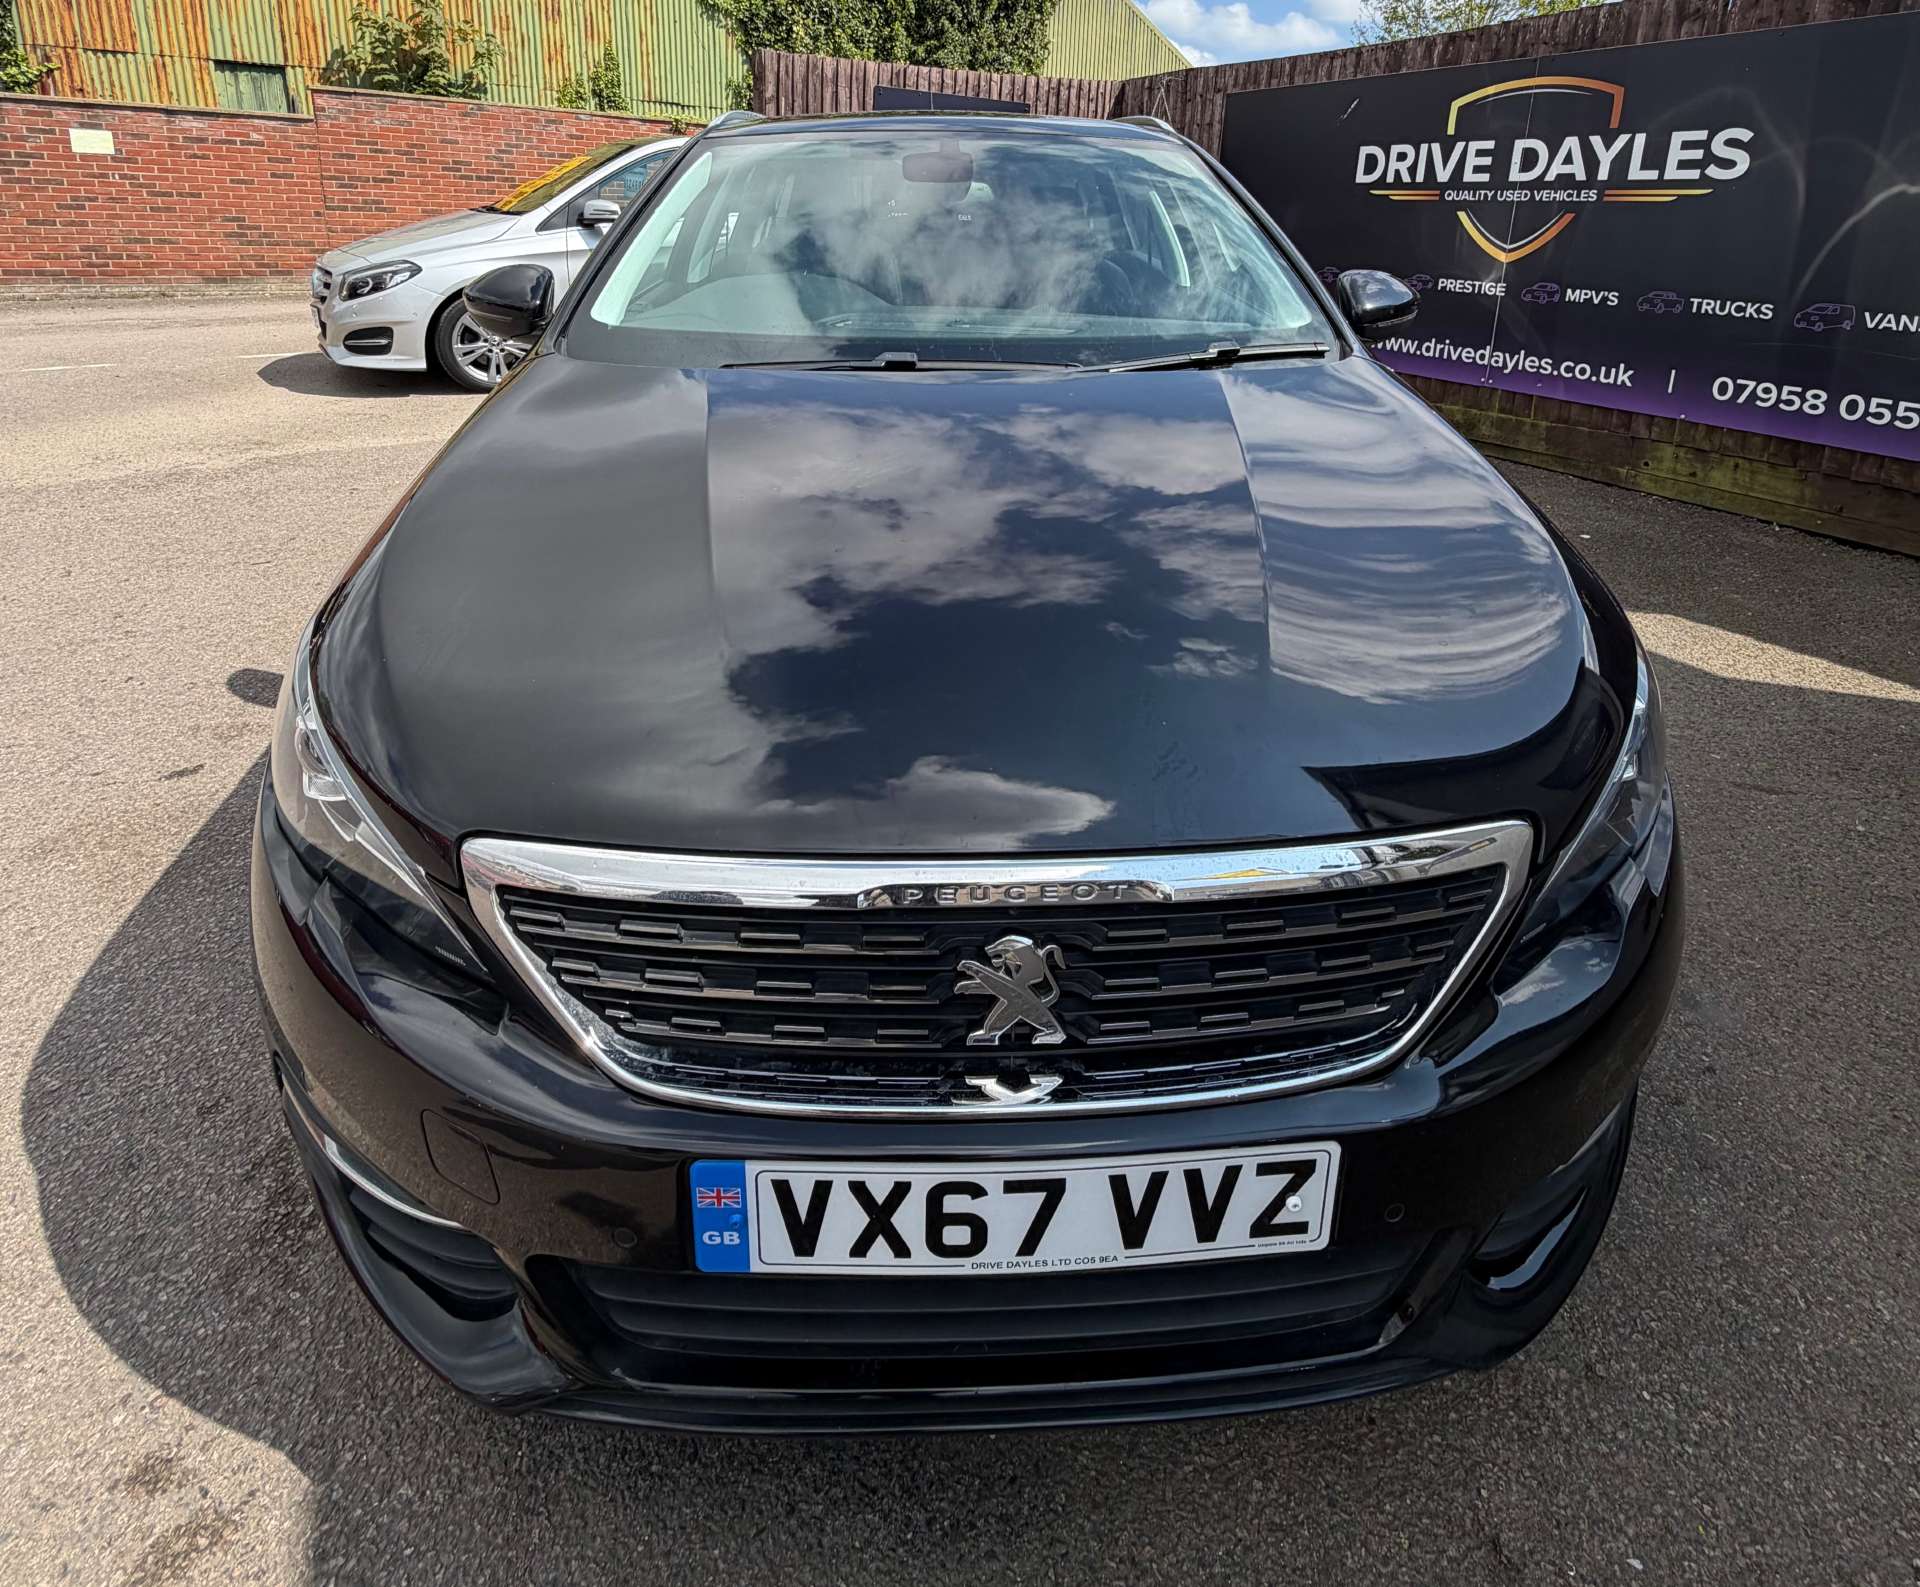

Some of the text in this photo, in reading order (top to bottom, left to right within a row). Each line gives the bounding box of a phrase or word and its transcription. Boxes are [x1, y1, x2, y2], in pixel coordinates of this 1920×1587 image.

[1355, 127, 1755, 183] DRIVE DAYLES
[1444, 189, 1598, 202] QUALITY USED VEHICLES
[1437, 278, 1507, 296] PRESTIGE
[1690, 297, 1774, 320] TRUCKS
[1864, 311, 1920, 333] VAN
[1712, 376, 1828, 416] 07958
[1839, 394, 1920, 430] 055
[902, 884, 1128, 904] PEUGEOT
[770, 1158, 1317, 1259] VX67 VVZ
[702, 1231, 741, 1246] GB
[971, 1260, 1004, 1271] DRIVE
[1006, 1259, 1049, 1270] DAYLES
[1051, 1258, 1072, 1268] LTD
[1098, 1255, 1119, 1265] 9EA
